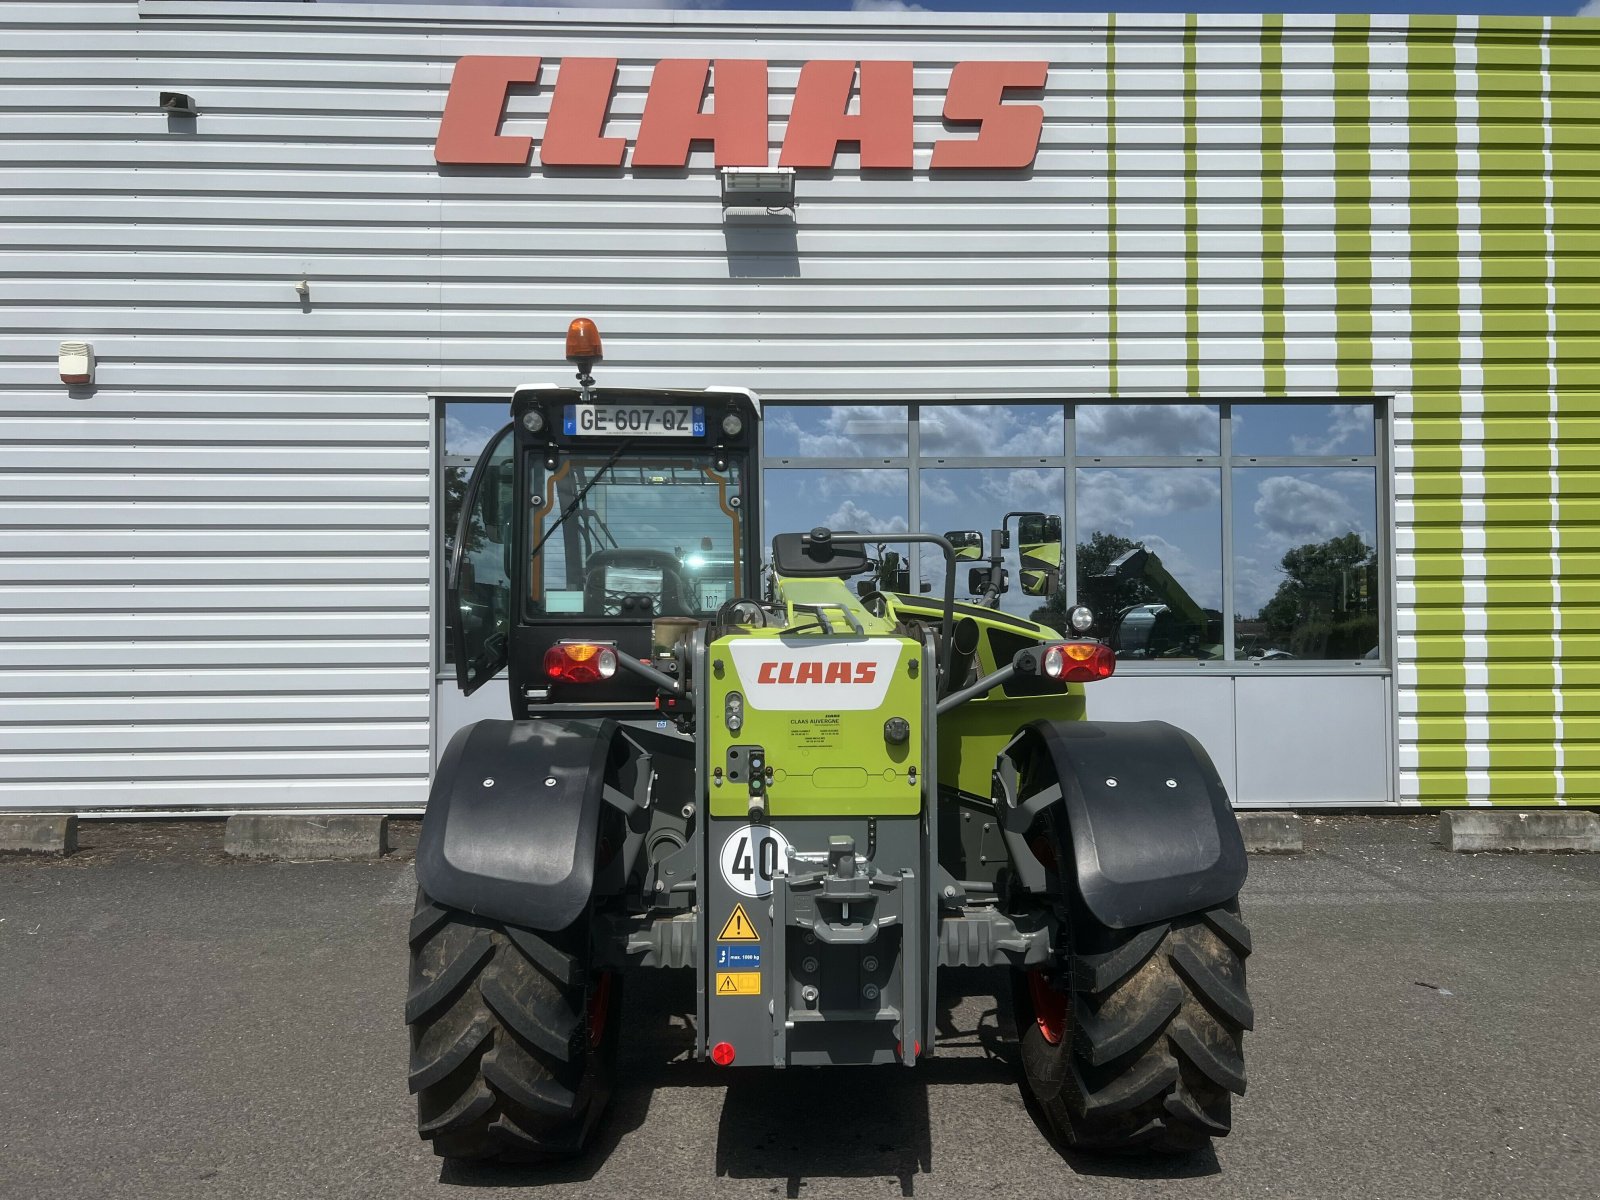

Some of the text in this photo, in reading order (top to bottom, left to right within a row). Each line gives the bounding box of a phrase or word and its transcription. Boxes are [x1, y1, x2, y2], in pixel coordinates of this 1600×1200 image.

[434, 55, 1049, 169] CLAAS
[581, 409, 689, 431] GE-607-QZ
[694, 422, 704, 432] 63
[705, 595, 718, 609] 107
[757, 662, 877, 684] CLAAS
[732, 836, 779, 881] 40
